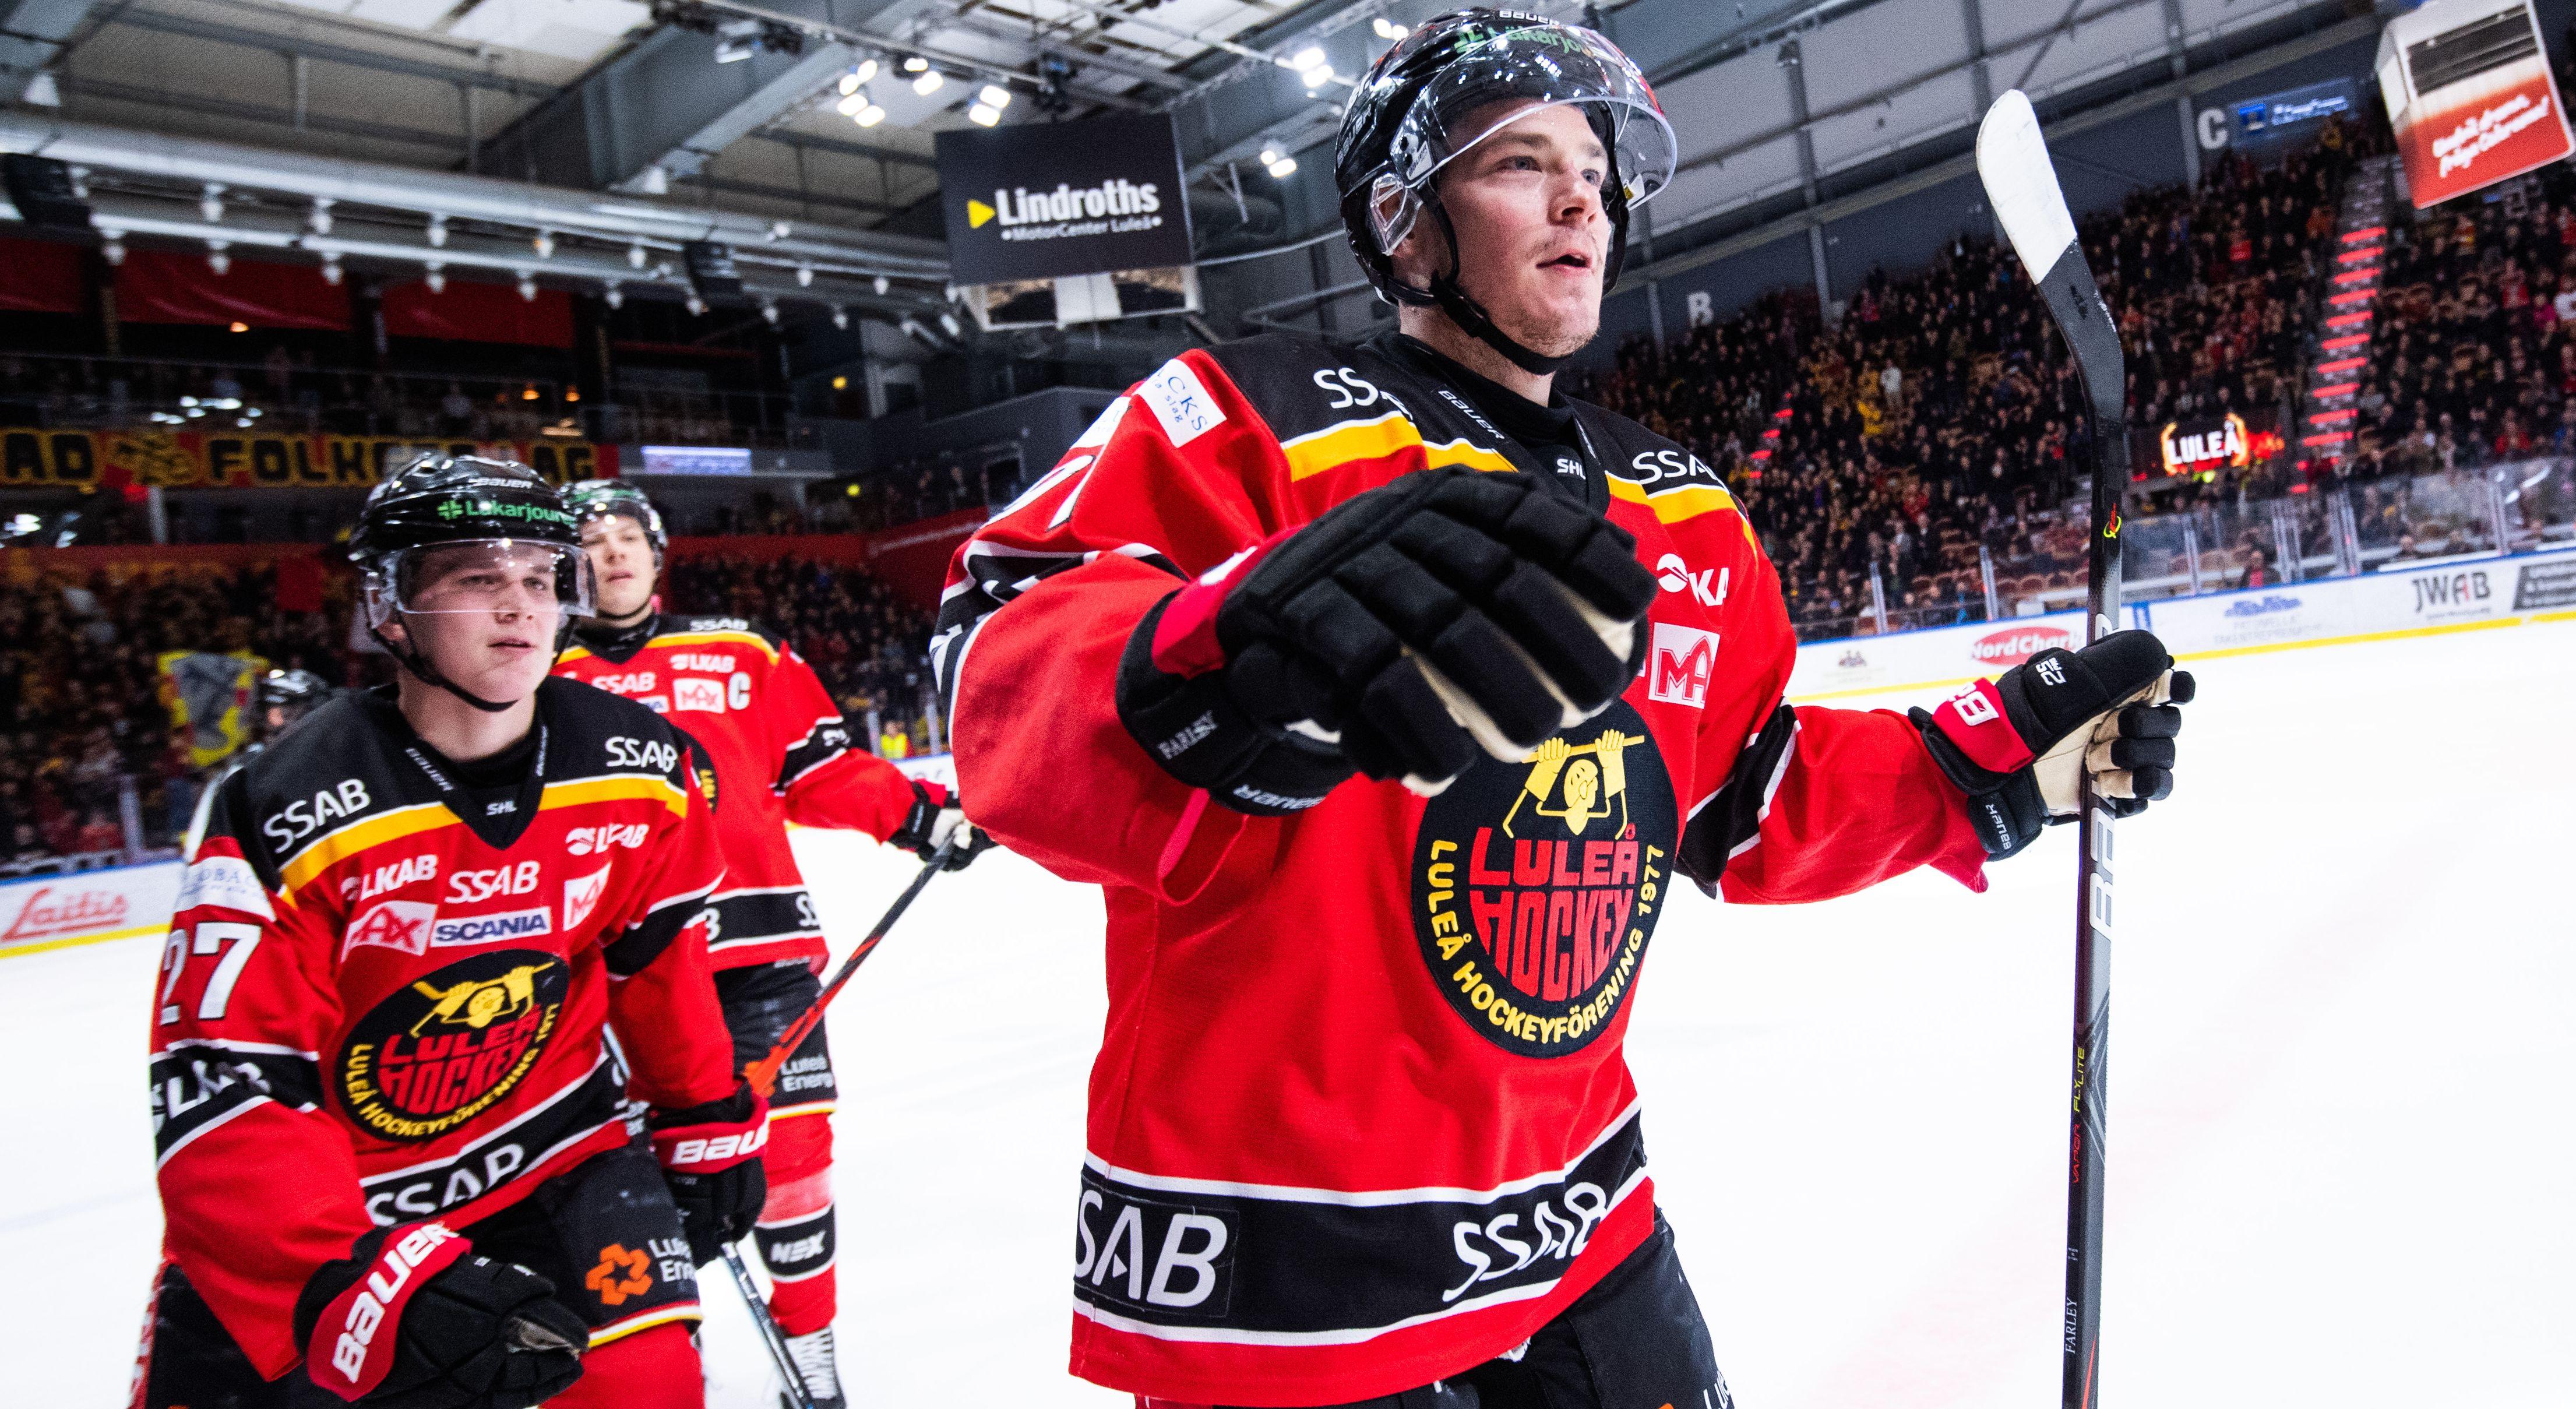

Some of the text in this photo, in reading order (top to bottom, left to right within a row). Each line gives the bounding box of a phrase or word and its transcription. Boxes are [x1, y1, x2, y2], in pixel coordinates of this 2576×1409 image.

[2197, 108, 2228, 150] C
[995, 178, 1161, 227] Lindroths
[1687, 291, 1714, 326] B
[1438, 390, 1504, 439] BAUER
[2167, 418, 2243, 465] LULEÅ
[2412, 570, 2491, 614] JWAB
[690, 617, 749, 632] SSAB
[591, 671, 656, 695] SSAB
[727, 671, 751, 711] C
[605, 735, 679, 773] SSAB
[263, 777, 372, 855] SSAB
[485, 799, 518, 816] SHL
[359, 853, 439, 903] LKAB
[1469, 822, 1639, 886] LULEÅ
[443, 860, 542, 904] SSAB
[435, 913, 548, 943] SCANIA
[1428, 839, 1665, 1044] LULEÅ HOCKEYFÖRENING 1977
[1468, 887, 1634, 1002] HOCKEY
[2073, 1047, 2086, 1113] FLYLITE
[1073, 1188, 1229, 1309] SAB
[1442, 1181, 1606, 1302] SSAB
[332, 1220, 460, 1385] BAUER
[2064, 1297, 2078, 1355] FARLEY
